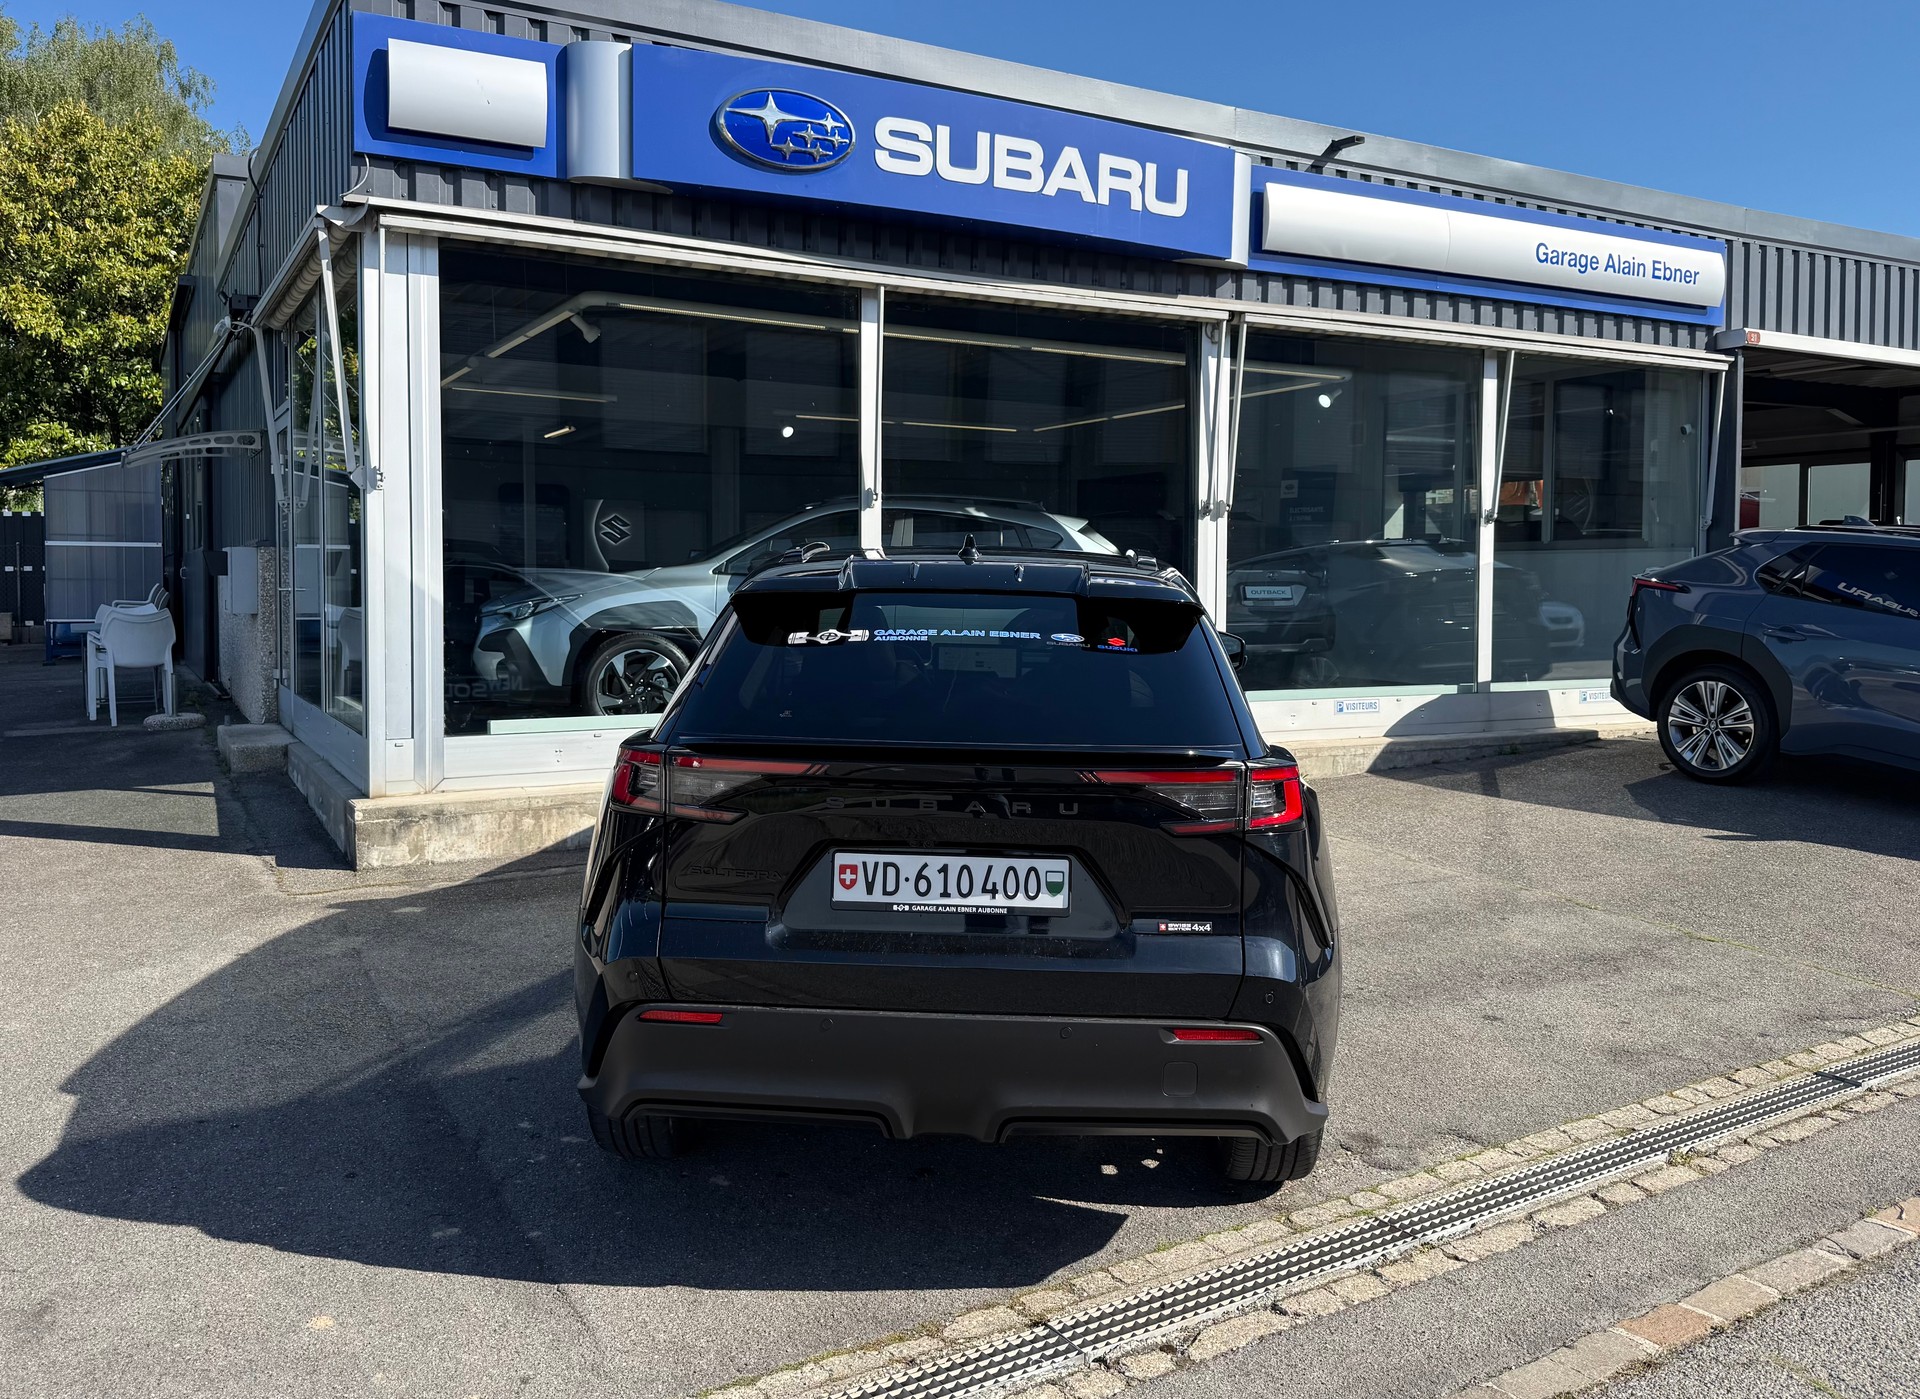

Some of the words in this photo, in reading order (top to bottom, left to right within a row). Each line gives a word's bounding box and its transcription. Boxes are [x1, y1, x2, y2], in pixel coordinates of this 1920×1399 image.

[874, 117, 1188, 217] SUBARU
[1535, 242, 1600, 274] Garage
[1604, 253, 1646, 278] Alain
[1651, 259, 1700, 285] Ebner
[940, 629, 986, 637] ALAIN
[989, 631, 1042, 640] EBNER
[1046, 641, 1091, 649] SUBARU
[1097, 644, 1139, 652] SUZUKI
[1589, 691, 1610, 700] VISITEU
[1345, 701, 1378, 711] VISITEURS
[825, 796, 1079, 815] SUBARU
[690, 865, 783, 879] SOLTERRA
[1192, 923, 1211, 932] 4x4
